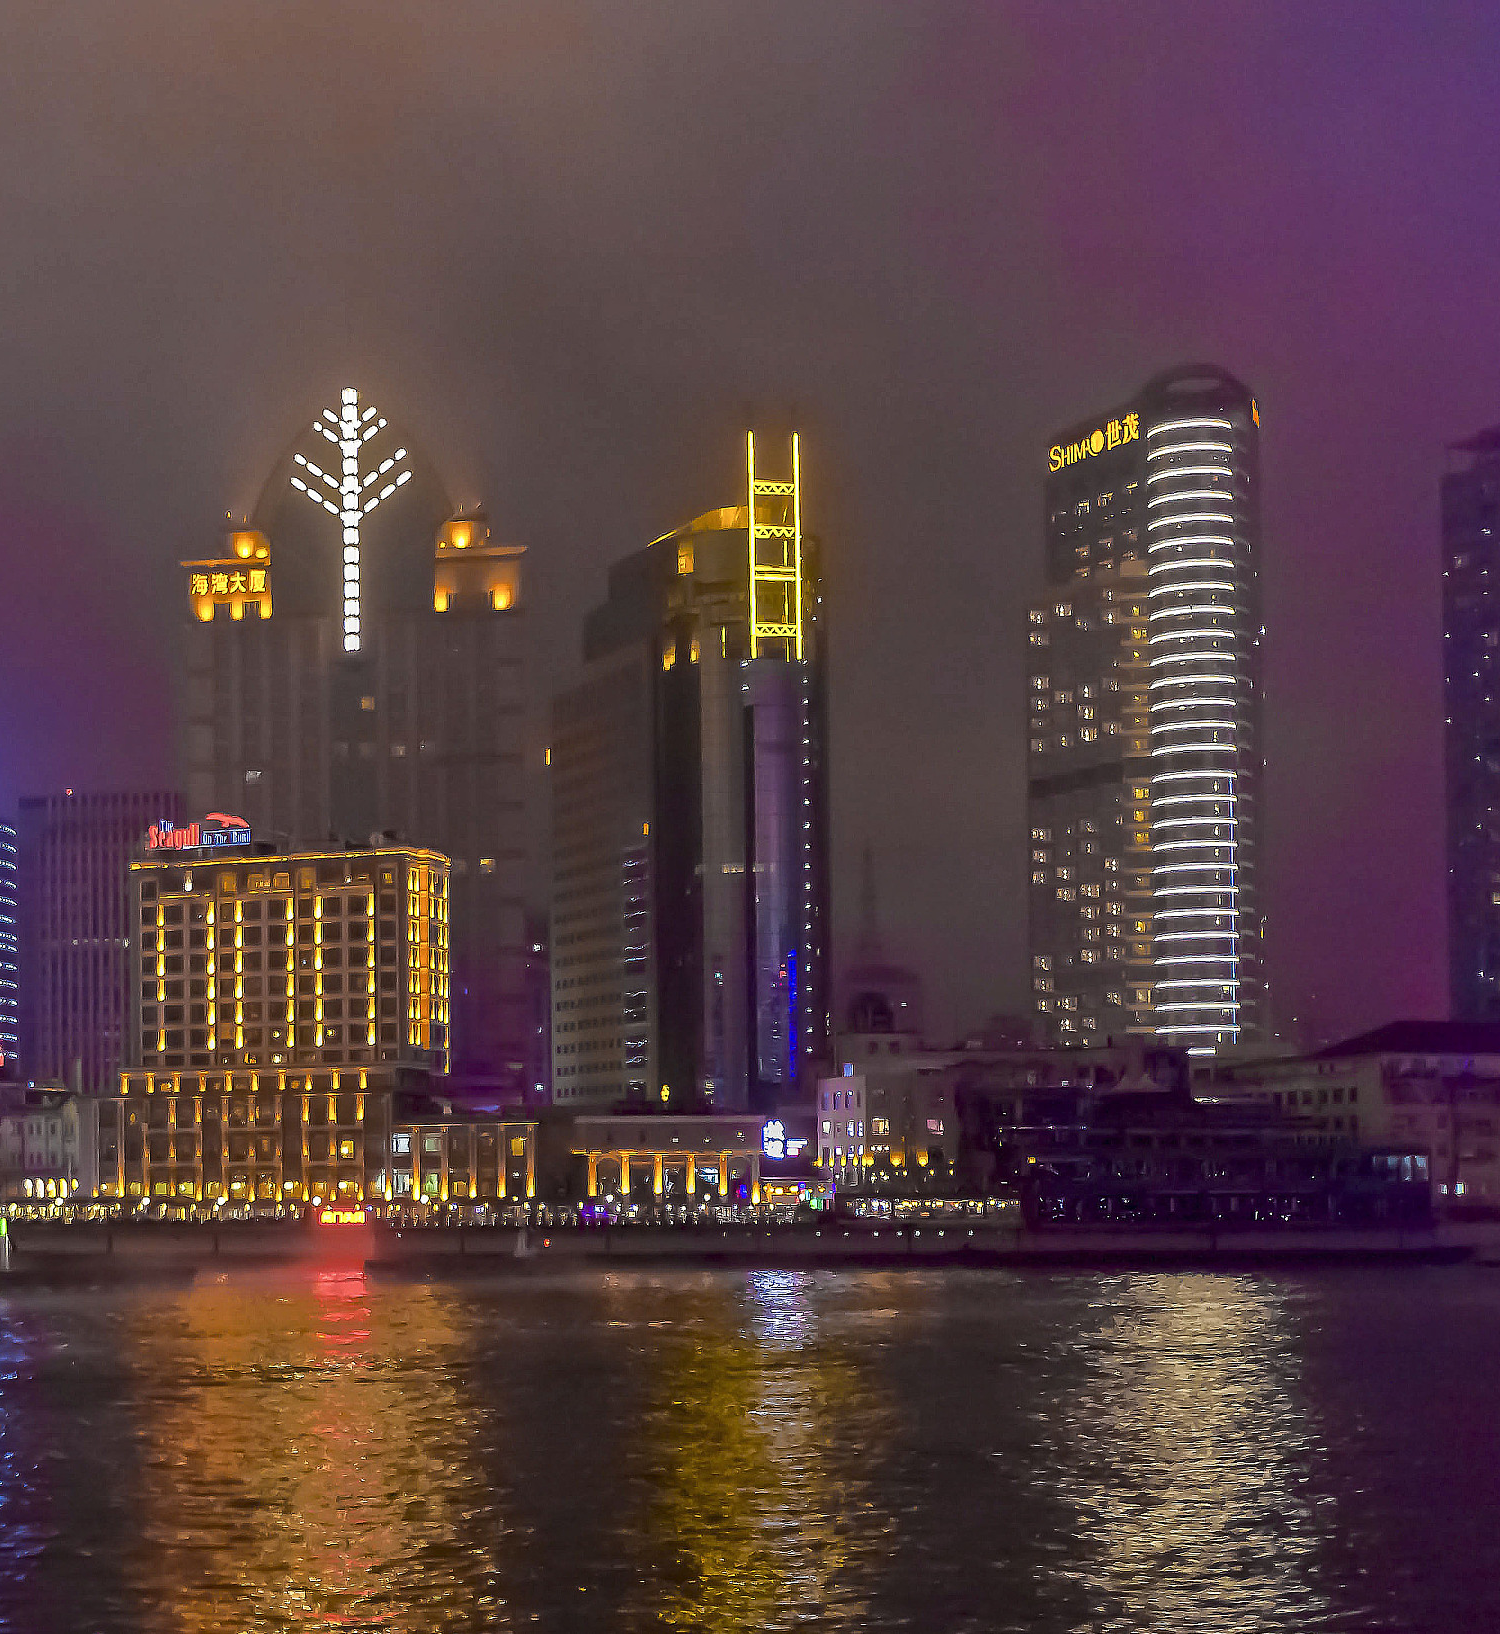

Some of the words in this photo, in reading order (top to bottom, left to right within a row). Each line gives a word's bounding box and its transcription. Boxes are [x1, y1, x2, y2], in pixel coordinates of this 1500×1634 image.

[1105, 412, 1140, 451] 世茂
[191, 569, 267, 596] 海湾大厦
[148, 823, 201, 850] Seagull
